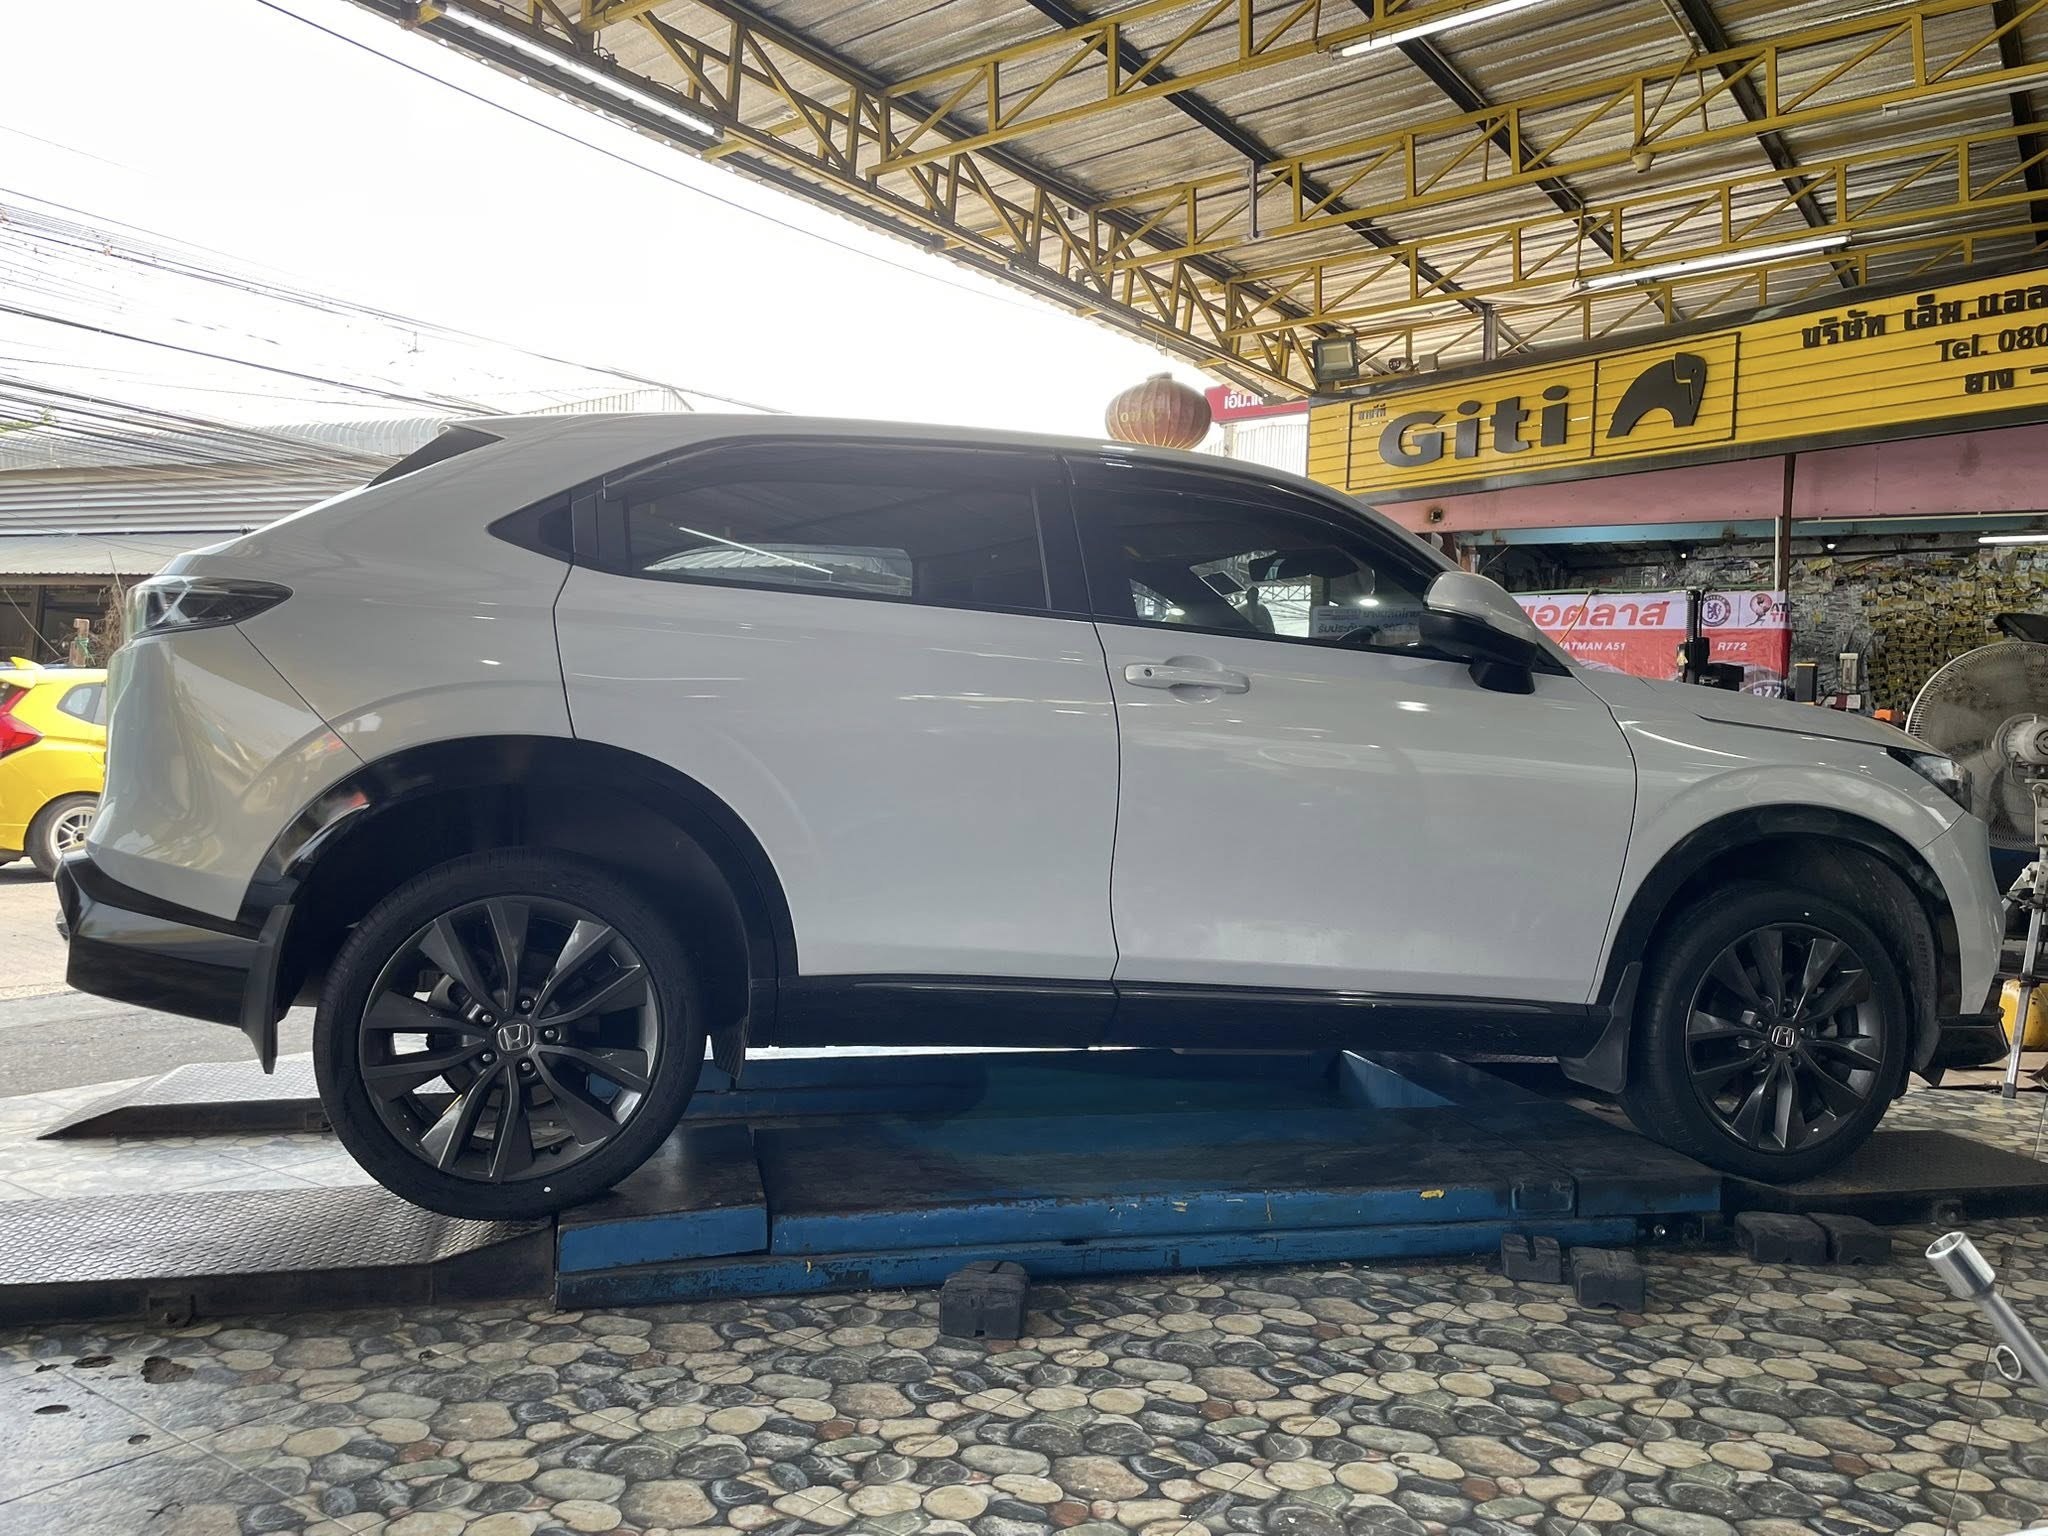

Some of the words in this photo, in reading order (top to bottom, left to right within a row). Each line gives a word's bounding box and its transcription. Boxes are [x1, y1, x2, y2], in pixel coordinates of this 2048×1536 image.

[1802, 310, 1886, 348] บริษัท
[1936, 334, 1988, 361] Tel.
[1998, 323, 2048, 352] 080
[1965, 368, 2014, 394] ยาง
[1378, 385, 1569, 468] Giti
[1604, 641, 1626, 651] A51
[1717, 641, 1748, 651] R772
